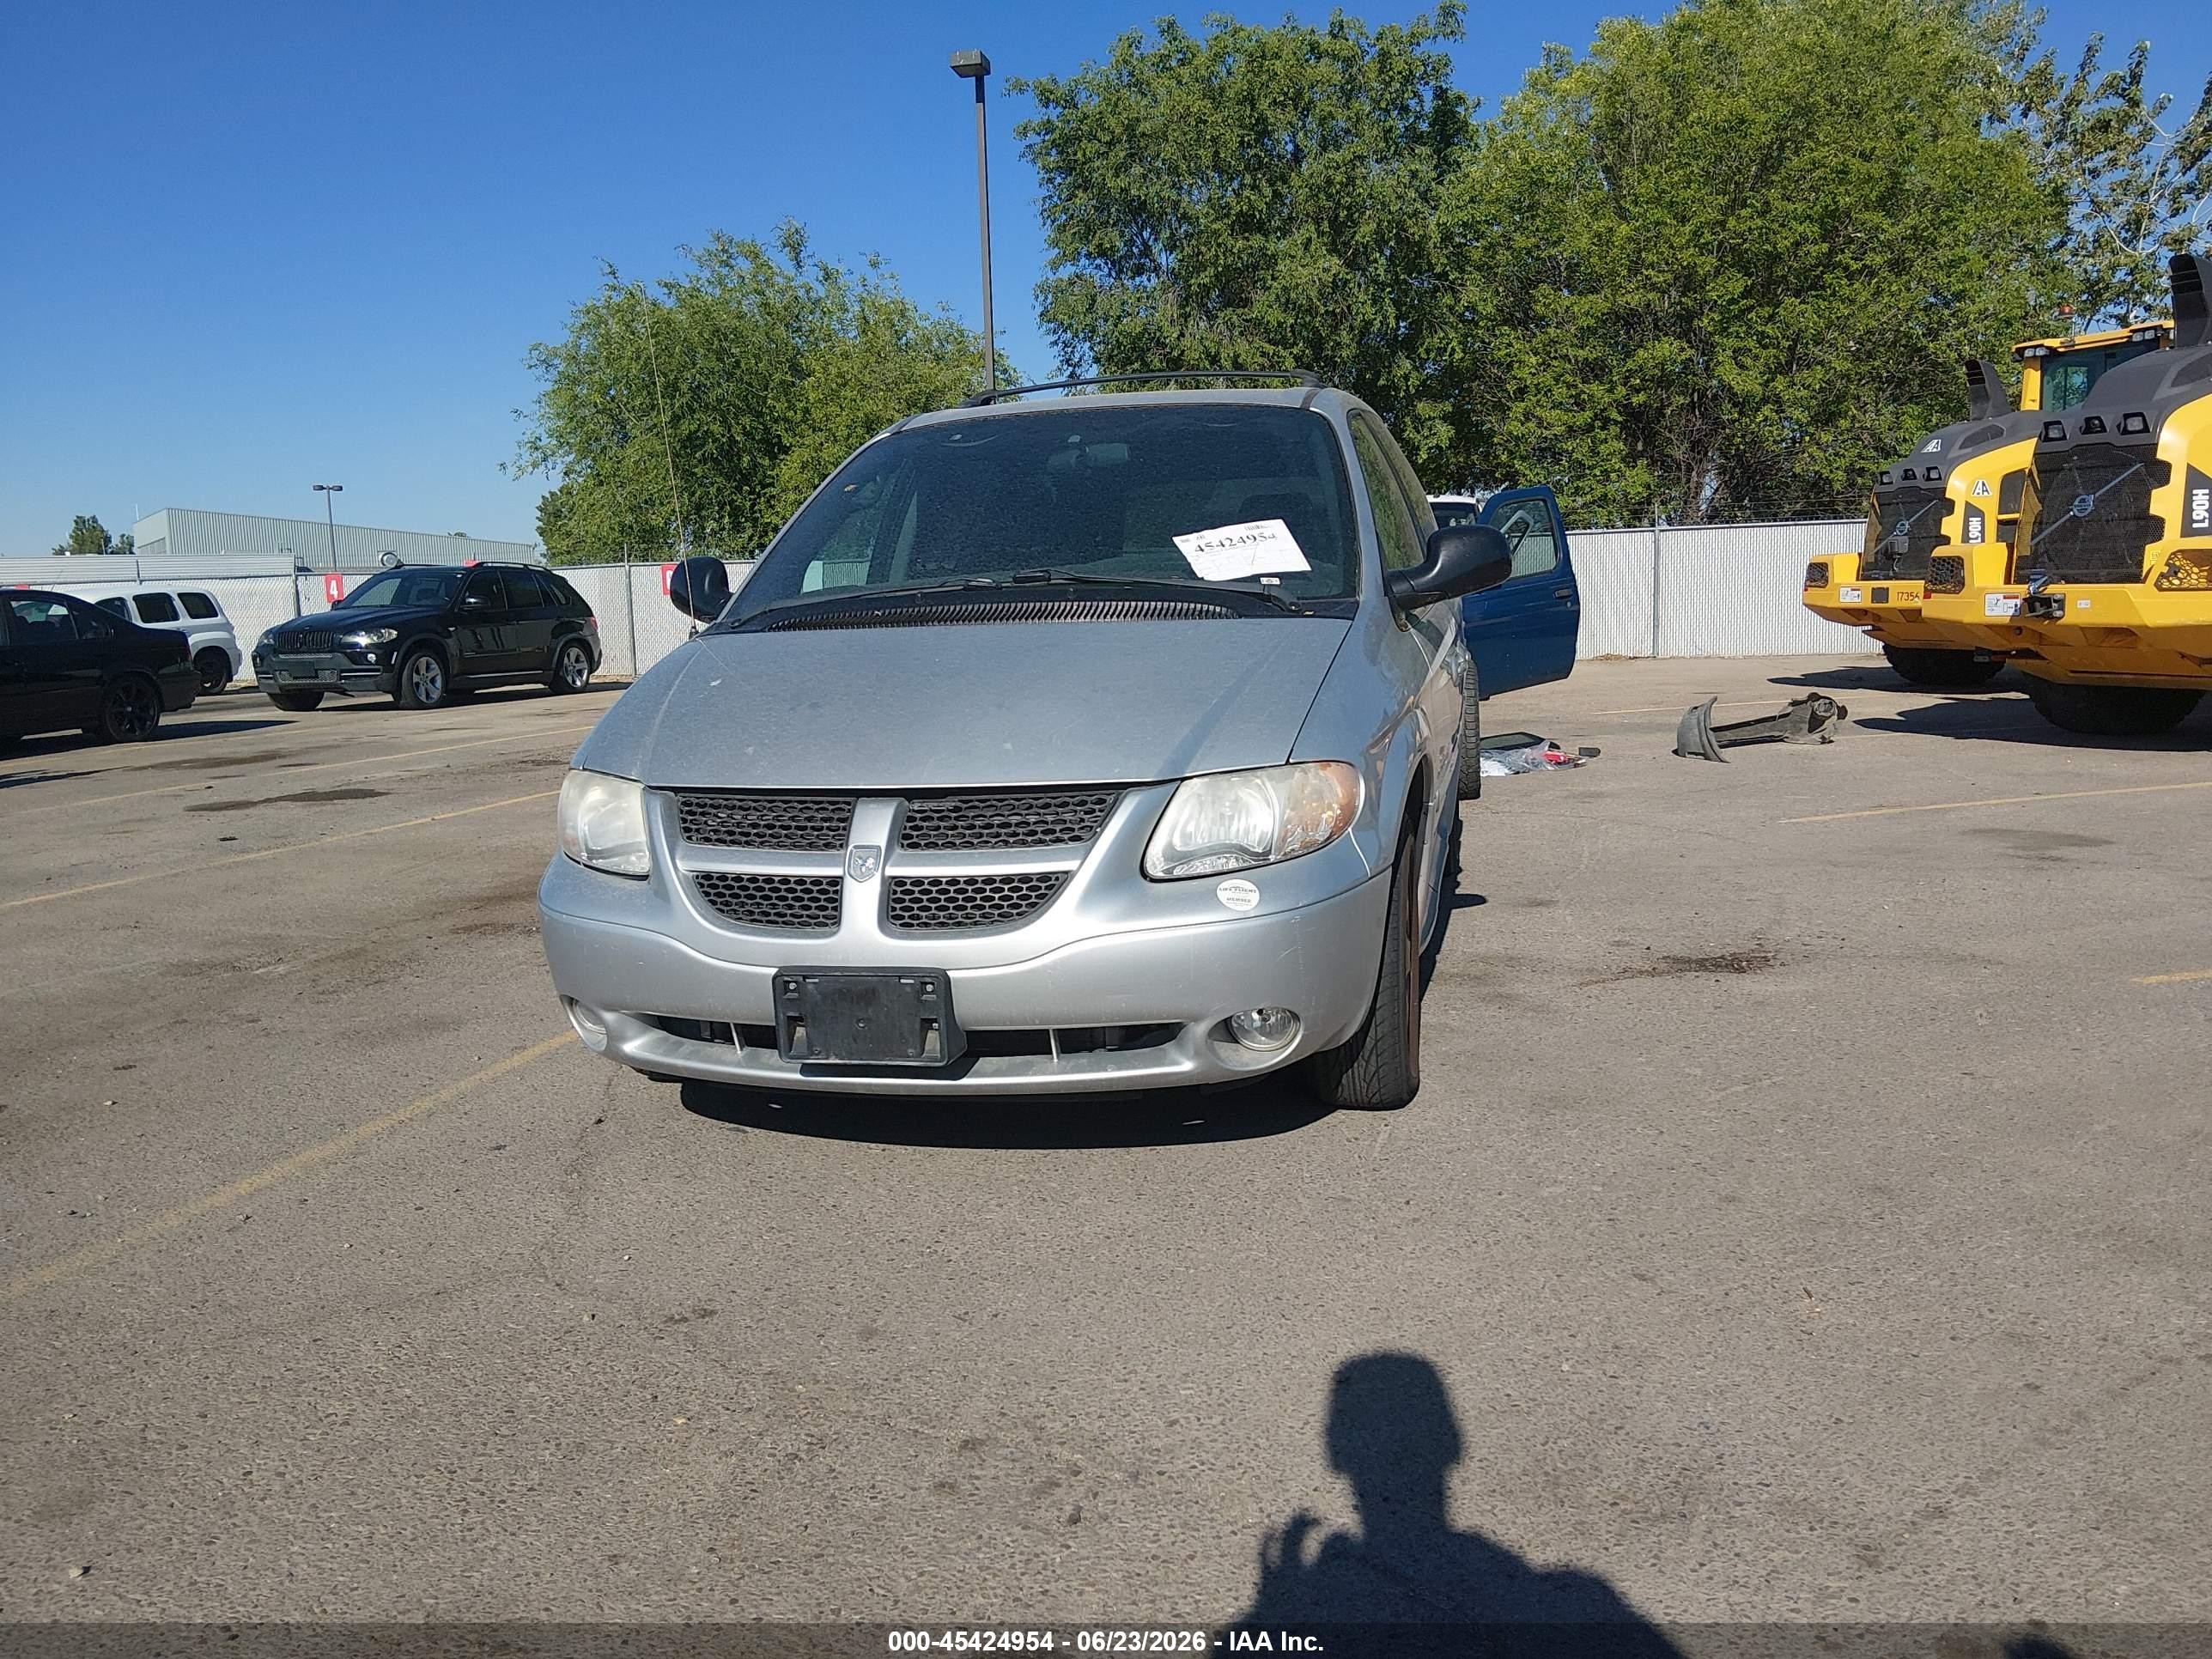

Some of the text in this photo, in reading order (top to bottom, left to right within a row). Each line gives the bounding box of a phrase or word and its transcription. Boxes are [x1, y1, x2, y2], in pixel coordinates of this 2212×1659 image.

[2192, 489, 2209, 528] L90H
[1969, 517, 1982, 543] L90H
[330, 580, 338, 599] 4
